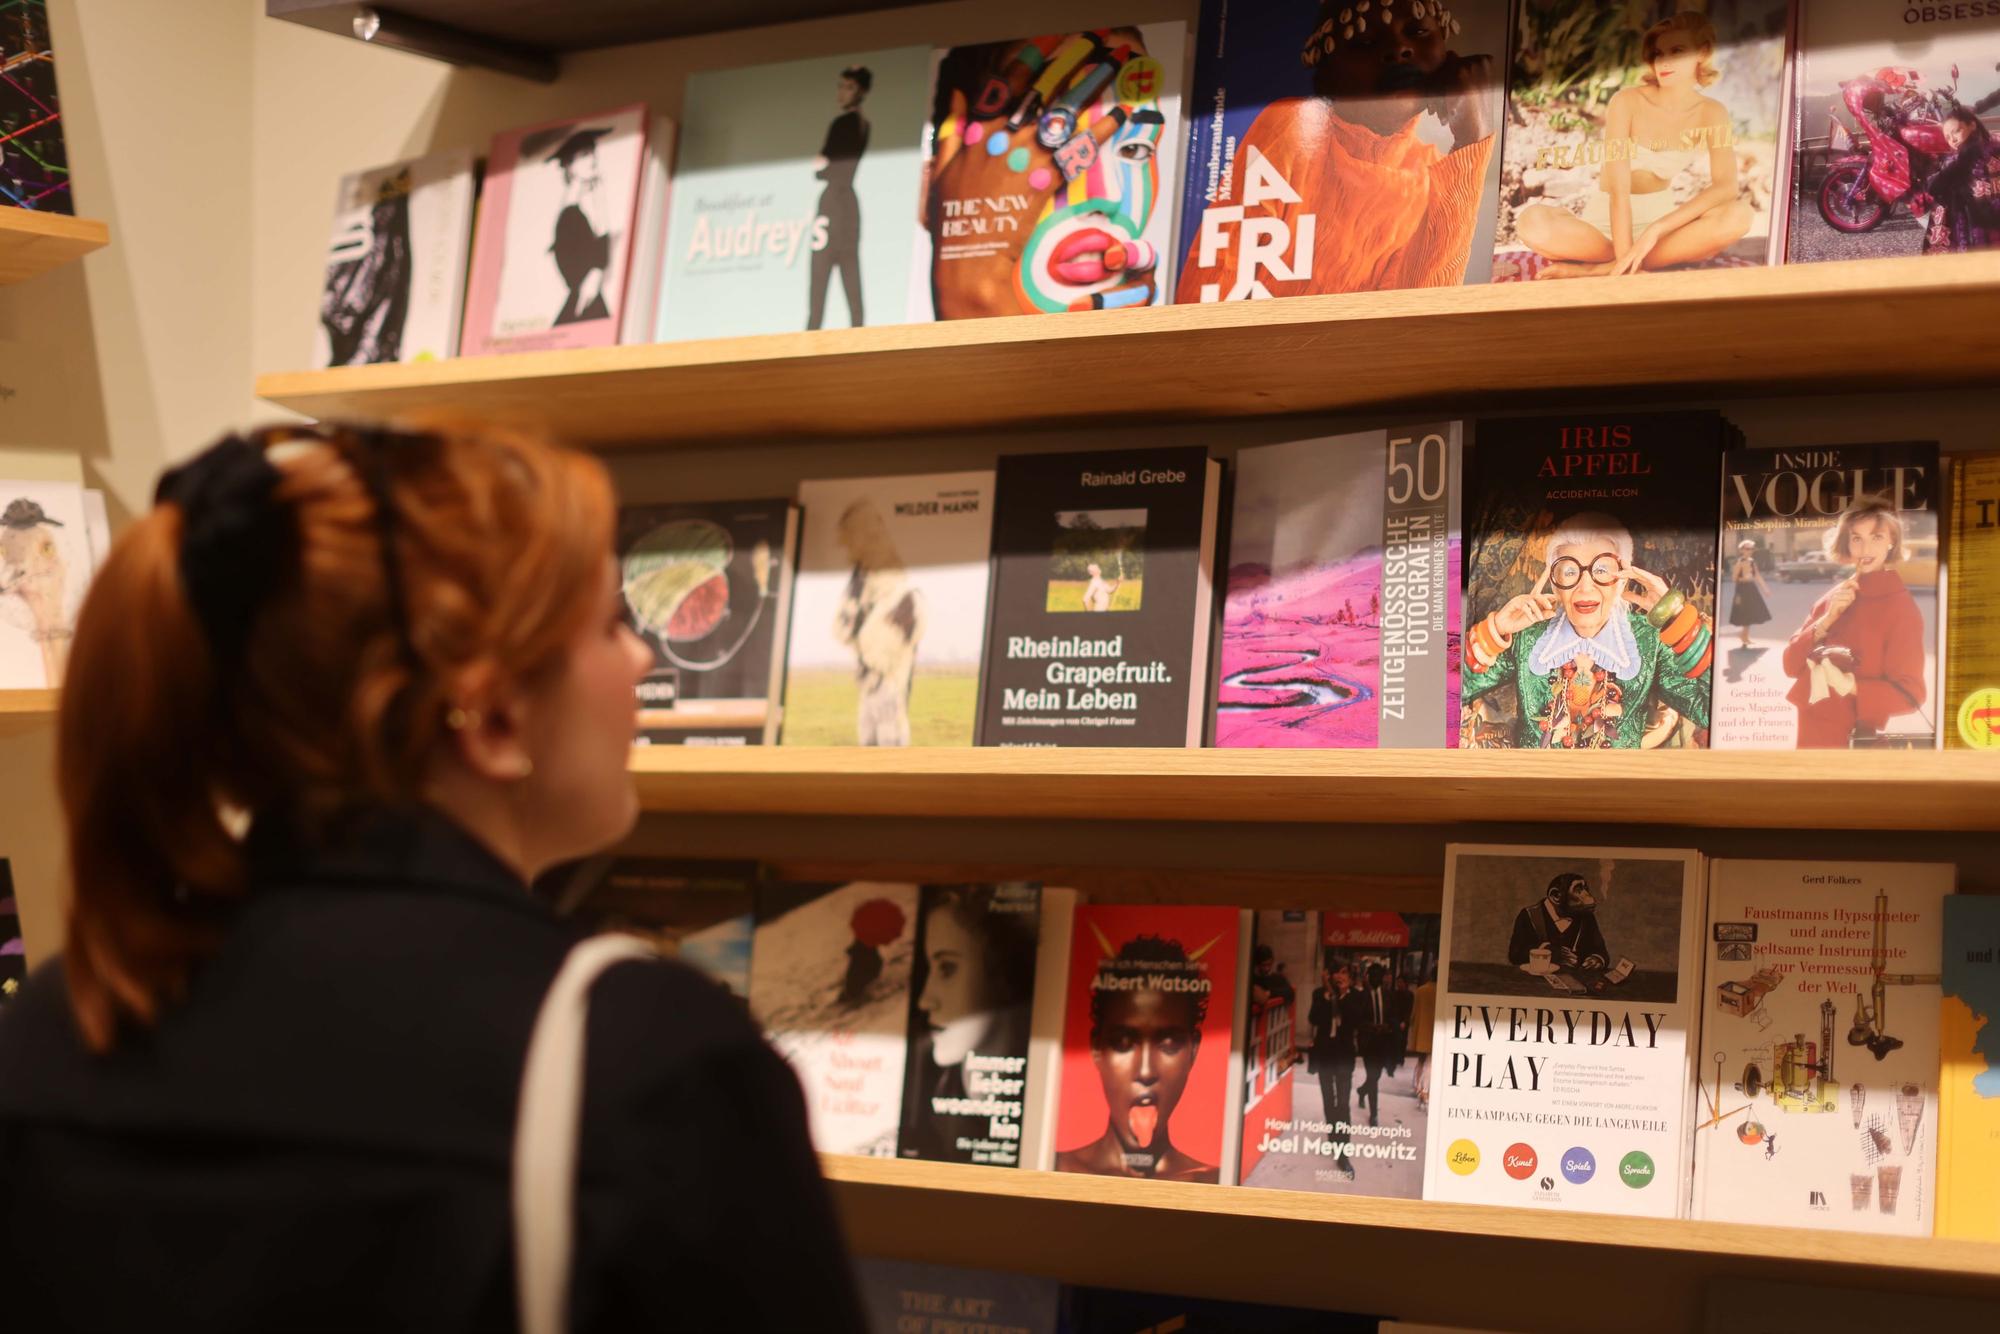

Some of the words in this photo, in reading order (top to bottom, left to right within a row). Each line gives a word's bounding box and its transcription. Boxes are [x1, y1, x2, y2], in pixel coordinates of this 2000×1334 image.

[1204, 87, 1226, 202] Atemberaubende
[1225, 135, 1236, 160] aus
[1536, 139, 1638, 171] FRAUEN
[1679, 125, 1738, 151] STIL
[1219, 162, 1234, 201] Mode
[1244, 145, 1303, 207] A
[943, 197, 981, 217] THE
[984, 194, 1031, 213] NEW
[942, 214, 1020, 238] BEAUTY
[687, 209, 830, 270] Audrey's
[1560, 425, 1632, 449] IRIS
[1388, 434, 1445, 504] 50
[1537, 452, 1652, 478] APFEL
[1774, 451, 1841, 470] INSIDE
[1081, 470, 1136, 487] Rainald
[1140, 469, 1186, 485] Grebe
[1546, 489, 1609, 500] ACCIDENTAL
[1612, 488, 1639, 497] ICON
[895, 501, 938, 516] WILDER
[942, 499, 979, 513] MANN
[1434, 513, 1446, 547] SOLLTE
[1726, 518, 1791, 532] Nina-Sophia
[1433, 550, 1445, 588] KENNEN
[1407, 514, 1430, 657] FOTOGRAFEN
[1433, 590, 1444, 612] MAN
[1380, 516, 1408, 720] ZEITGENÖSSISCHE
[1432, 615, 1443, 631] DIE
[1007, 635, 1122, 658] Rheinland
[1046, 661, 1172, 688] Grapefruit.
[1003, 688, 1060, 710] Mein
[1066, 688, 1137, 710] Leben
[1731, 688, 1784, 698] Geschichte
[1721, 704, 1745, 713] eines
[1749, 703, 1792, 715] Magazins
[1016, 717, 1065, 727] Zeichnungen
[1718, 718, 1737, 727] und
[1739, 717, 1756, 727] der
[1722, 733, 1737, 742] die
[1802, 875, 1825, 885] Gerd
[1828, 875, 1862, 886] Folkers
[1744, 906, 1829, 921] Faustmanns
[1833, 908, 1920, 924] Hypsometer
[1790, 926, 1817, 938] und
[1821, 926, 1871, 939] andere
[1753, 942, 1814, 956] seltsame
[1819, 943, 1907, 958] Instrumente
[1771, 962, 1795, 975] zur
[1800, 961, 1886, 979] Vermessung
[1090, 973, 1144, 990] Albert
[1148, 973, 1211, 992] Watson
[1798, 980, 1822, 993] der
[1826, 981, 1857, 994] Welt
[1451, 1004, 1667, 1048] EVERYDAY
[1448, 1052, 1549, 1091] PLAY
[970, 1071, 1024, 1095] lieber
[931, 1094, 1021, 1118] woanders
[990, 1116, 1020, 1139] hin
[1264, 1118, 1292, 1131] How
[1294, 1119, 1298, 1131] I
[1300, 1120, 1333, 1134] Make
[1335, 1121, 1412, 1138] Photographs
[1448, 1108, 1473, 1119] EINE
[1475, 1110, 1533, 1124] KAMPAGNE
[1535, 1114, 1570, 1126] GEGEN
[1573, 1116, 1592, 1128] DIE
[1596, 1117, 1668, 1132] LANGEWEILE
[1257, 1133, 1298, 1154] Joel
[1303, 1137, 1417, 1161] Meyerowitz
[1452, 1152, 1475, 1164] Leben
[1507, 1156, 1533, 1167] Kunst
[1566, 1160, 1591, 1173] Spiele
[1623, 1165, 1650, 1176] Sprache
